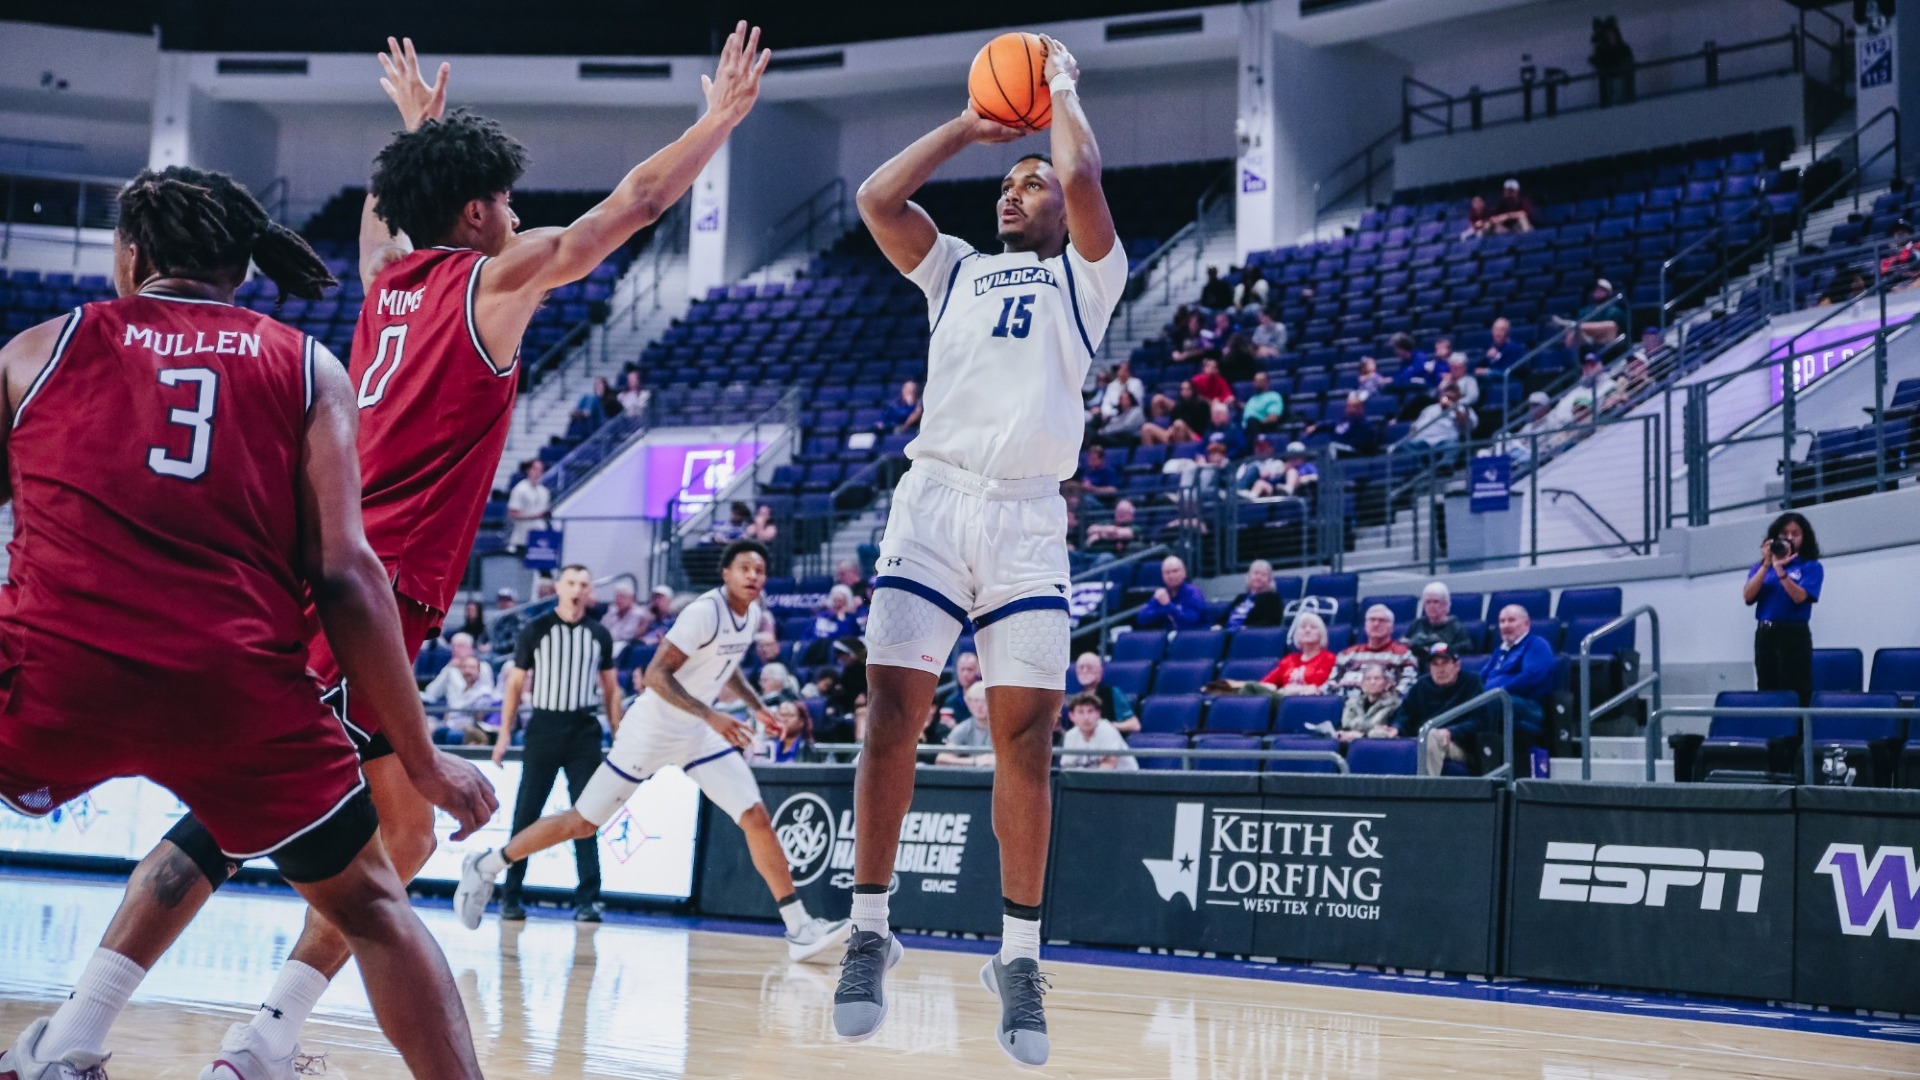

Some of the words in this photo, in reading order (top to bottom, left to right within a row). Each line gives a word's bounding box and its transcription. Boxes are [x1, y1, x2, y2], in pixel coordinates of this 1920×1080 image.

[991, 293, 1036, 339] 15
[123, 323, 261, 357] MULLEN
[357, 323, 409, 410] 0
[147, 366, 219, 481] 3
[1210, 815, 1334, 857] KEITH
[1347, 819, 1384, 859] &
[921, 878, 957, 894] GMC
[1207, 854, 1383, 901] LORFING
[1539, 841, 1765, 913] ESPN
[1243, 897, 1281, 914] WEST
[1326, 903, 1381, 920] TOUGH
